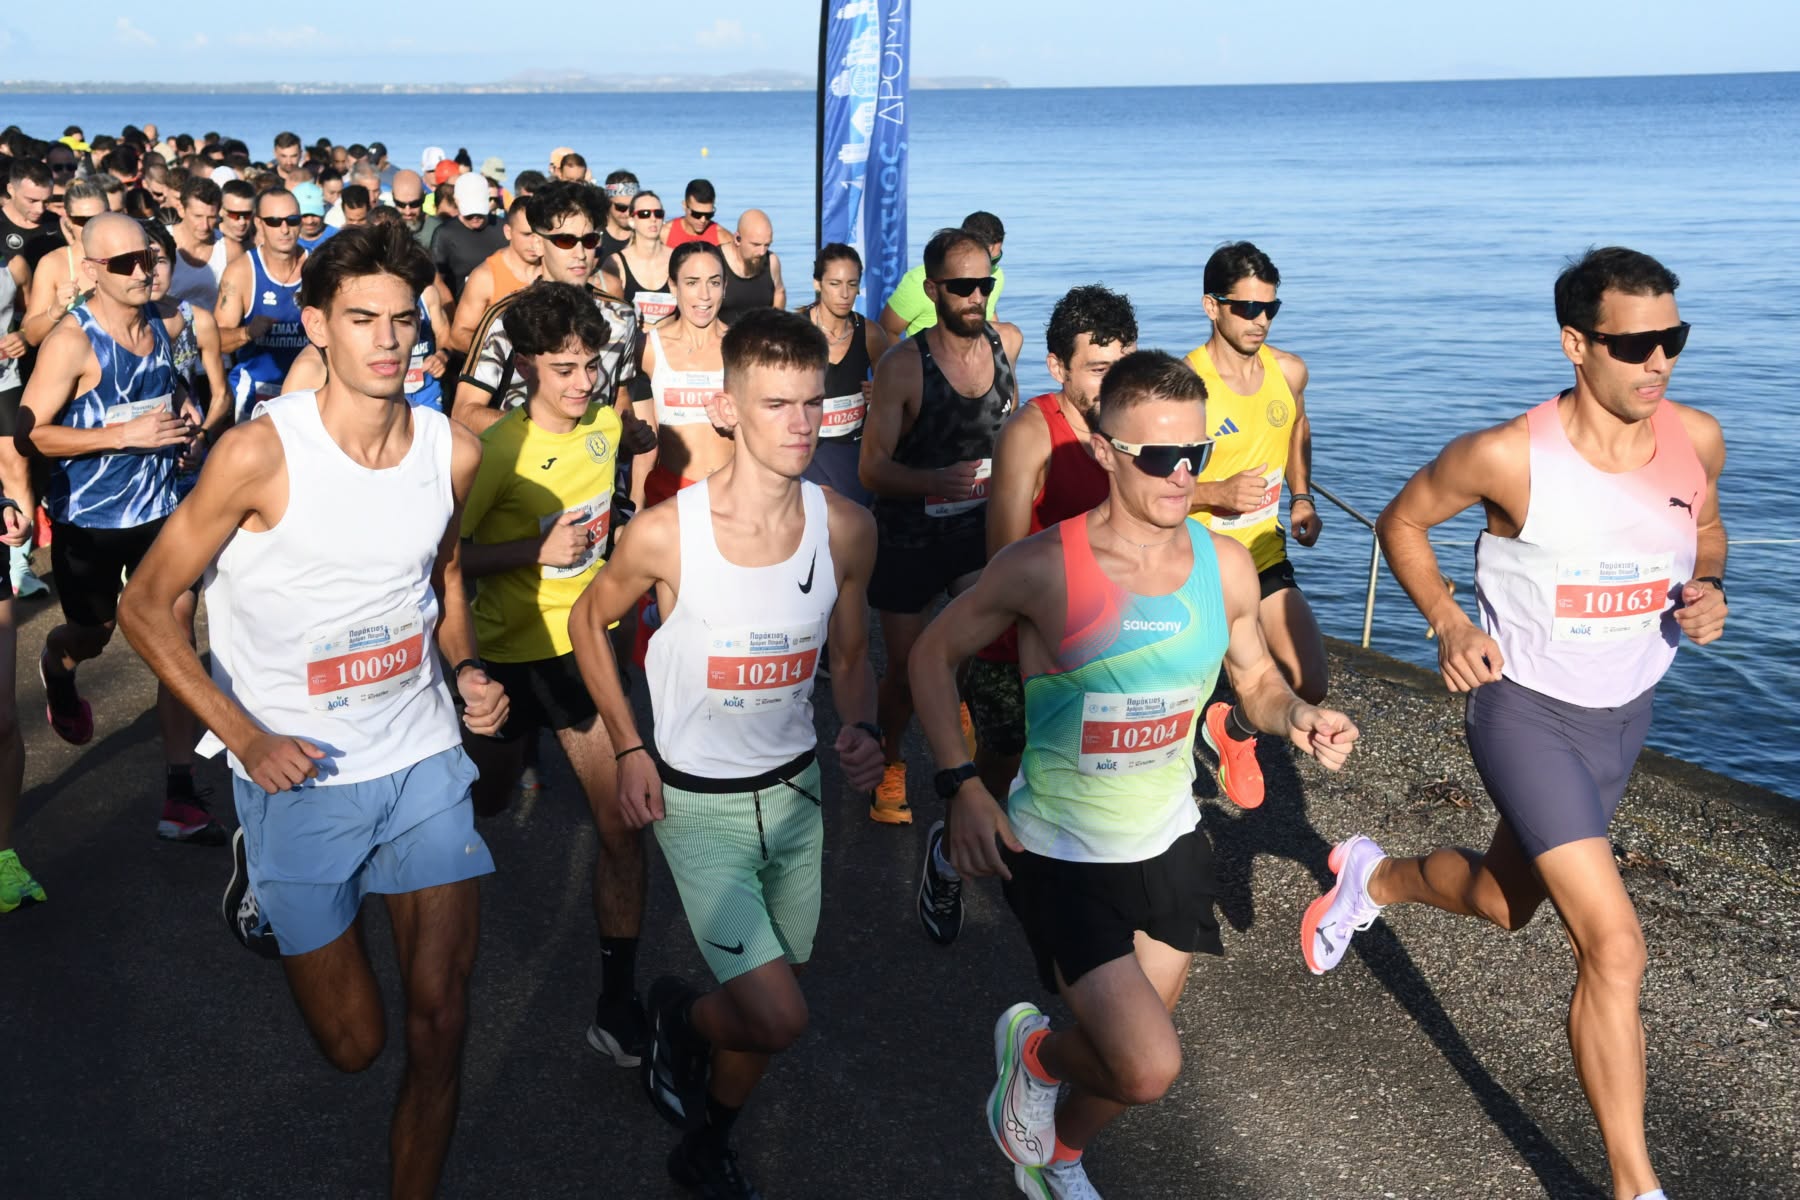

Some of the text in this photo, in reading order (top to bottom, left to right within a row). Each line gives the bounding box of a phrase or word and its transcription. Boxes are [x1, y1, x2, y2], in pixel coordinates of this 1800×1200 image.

[871, 142, 907, 309] άκτιος
[679, 391, 713, 405] 1017
[828, 410, 860, 425] 10265
[1584, 589, 1653, 613] 10163
[1123, 620, 1182, 633] saucony
[336, 648, 408, 686] 10099
[736, 658, 802, 685] 10214
[1110, 720, 1178, 749] 10204
